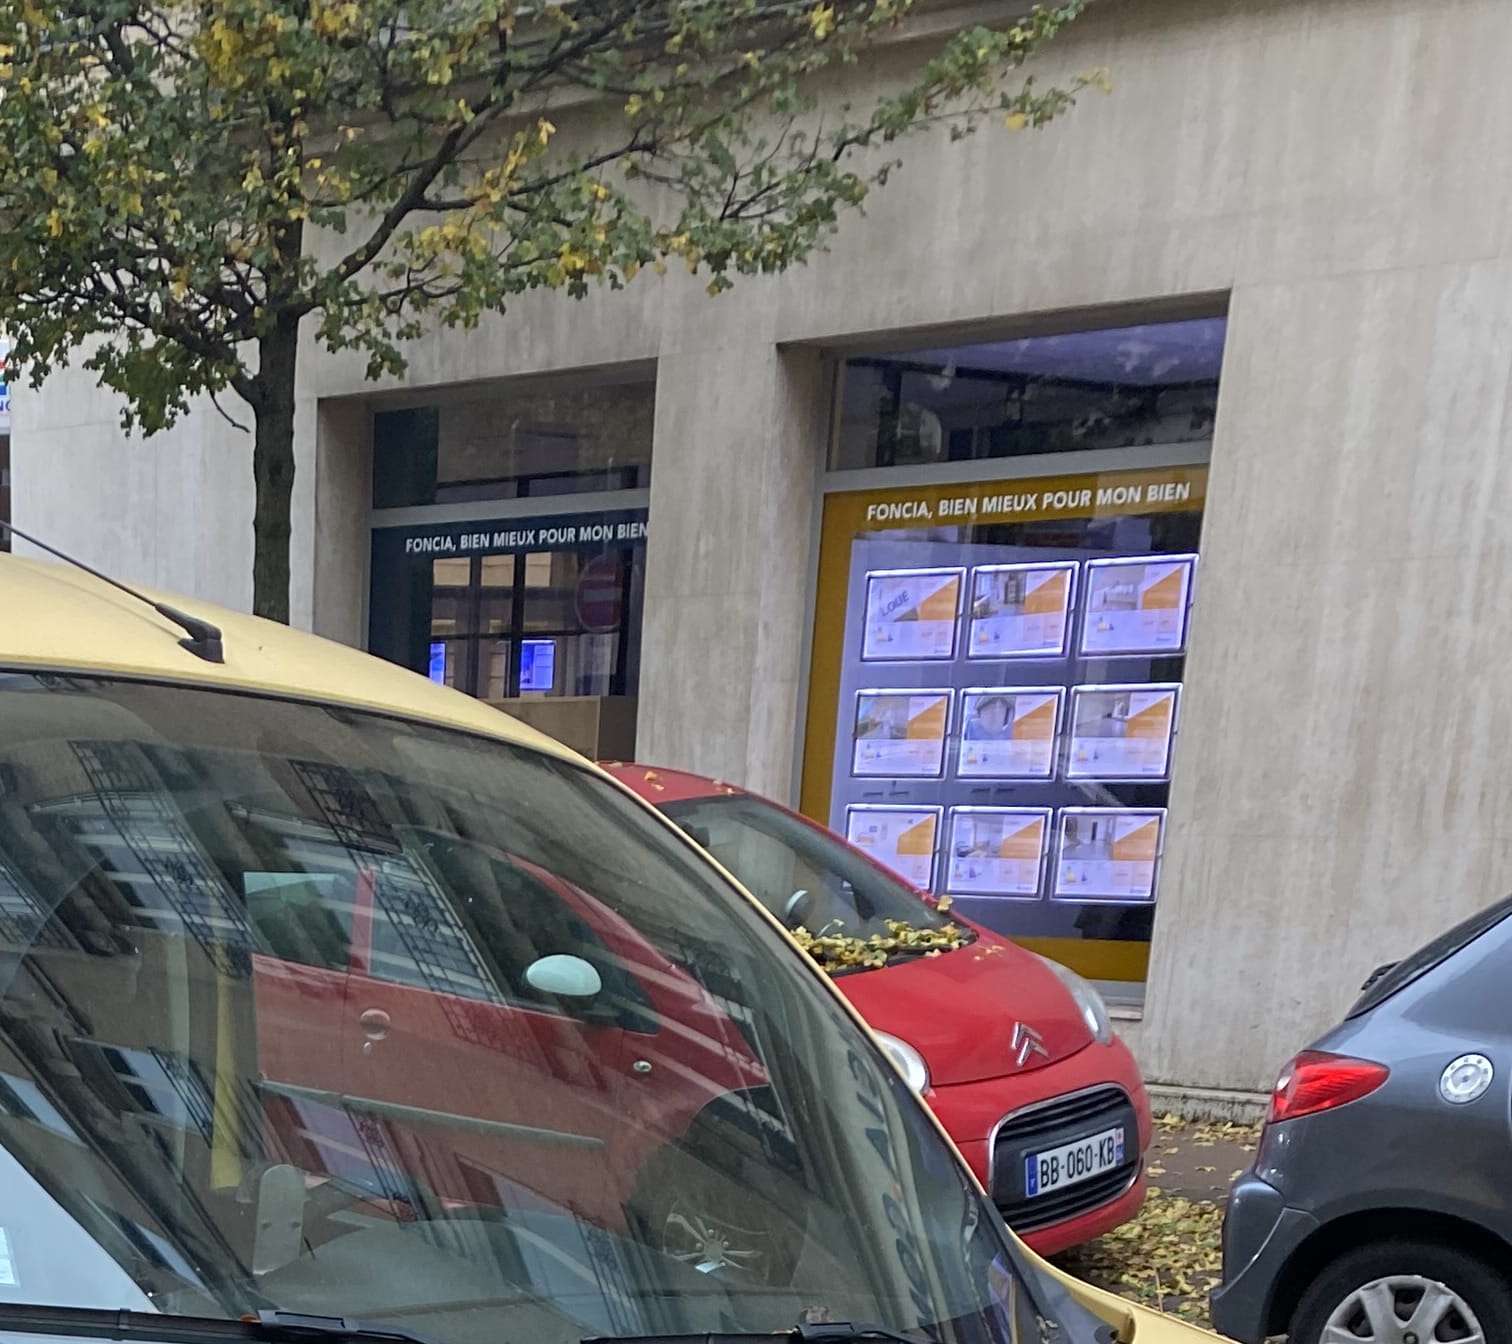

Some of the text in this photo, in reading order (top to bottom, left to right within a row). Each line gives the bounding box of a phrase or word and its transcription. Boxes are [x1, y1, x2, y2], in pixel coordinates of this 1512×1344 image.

[866, 481, 1191, 521] FONCIA, BIEN MIEUX POUR MON BIEN
[405, 521, 649, 553] FONCIA, BIEN MIEUX POUR MON BIEN
[1040, 1136, 1115, 1189] BB-060-KB
